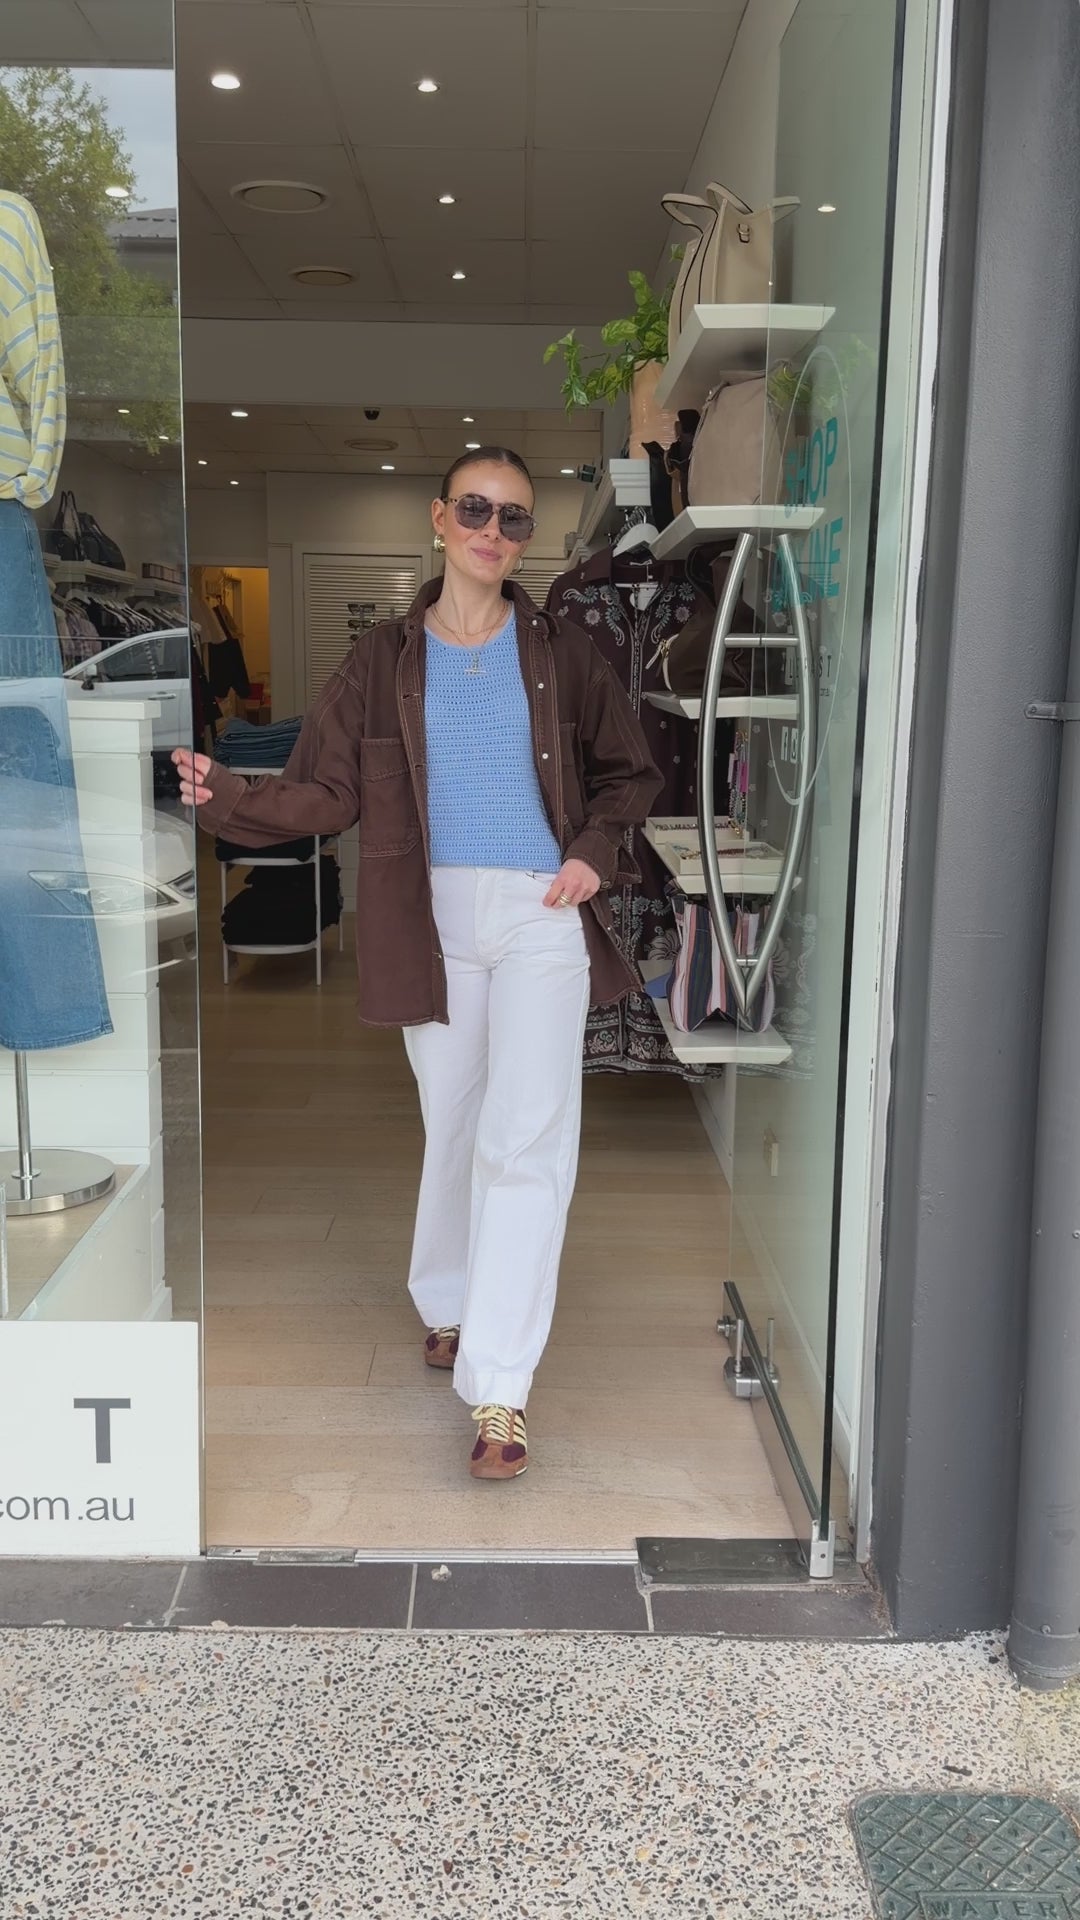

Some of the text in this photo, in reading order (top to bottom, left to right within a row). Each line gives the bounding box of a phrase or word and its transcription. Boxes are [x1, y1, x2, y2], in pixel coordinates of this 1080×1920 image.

[784, 417, 838, 519] SHOP
[772, 517, 843, 614] OLINE
[73, 1397, 131, 1464] T
[0, 1496, 134, 1521] om.au
[931, 1900, 1058, 1918] WATER
